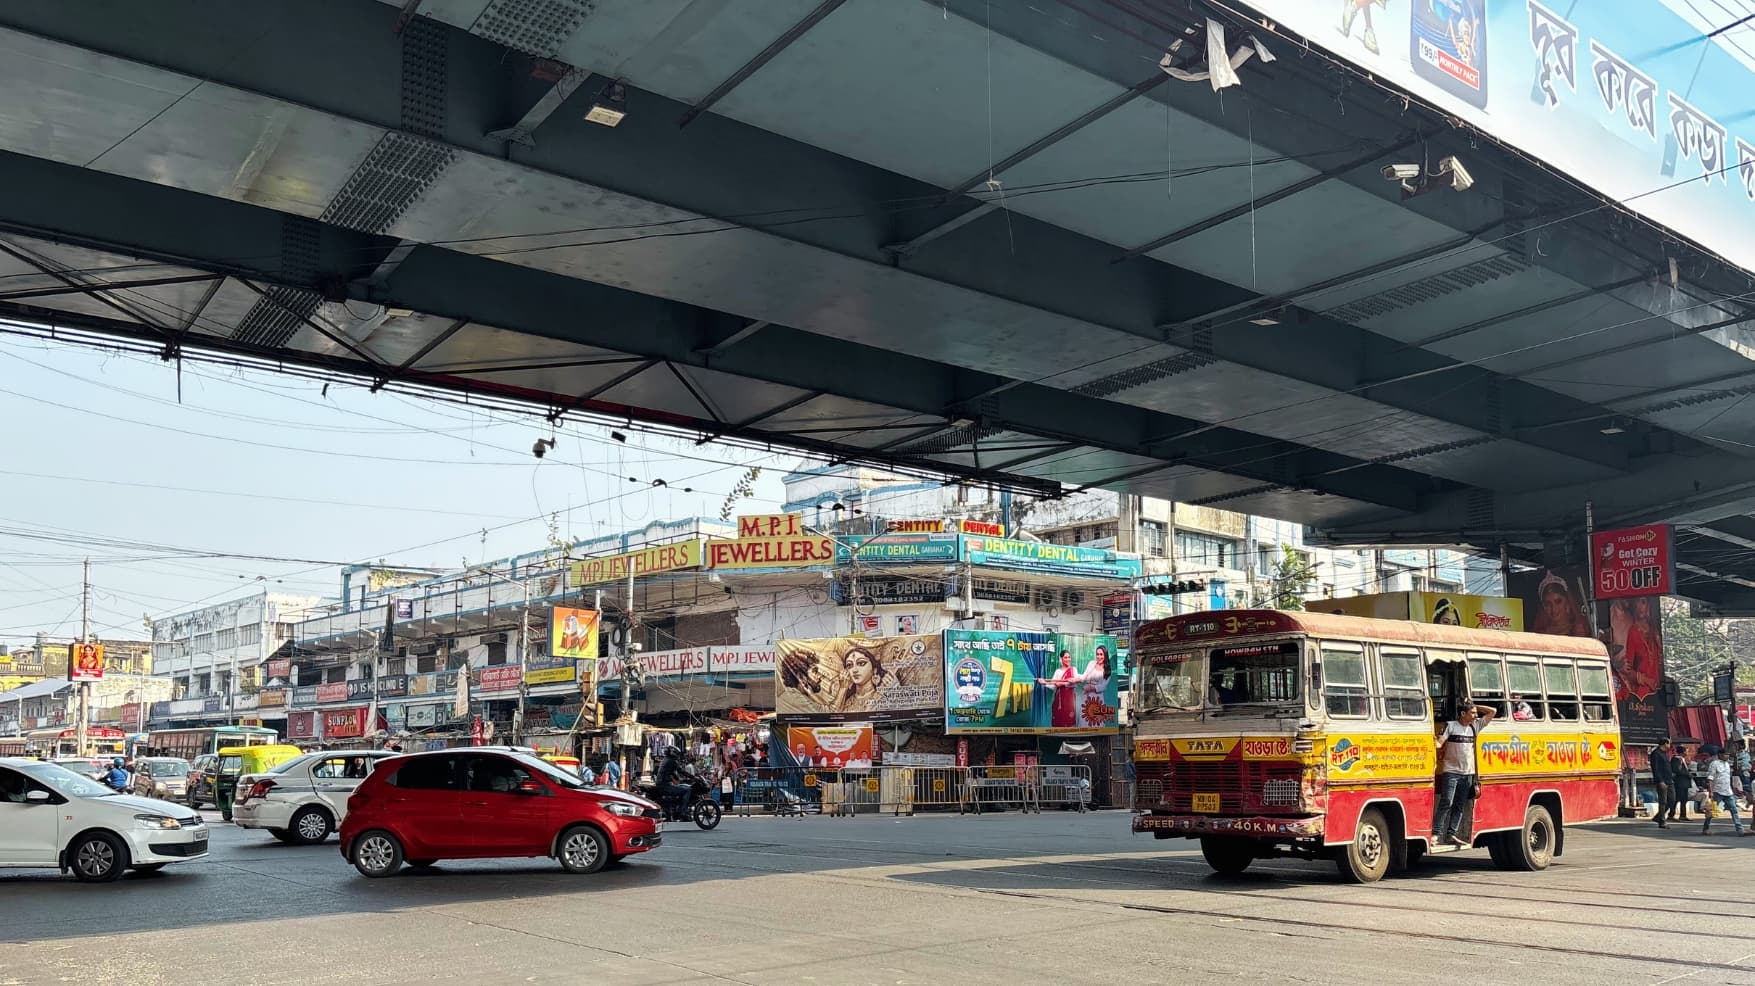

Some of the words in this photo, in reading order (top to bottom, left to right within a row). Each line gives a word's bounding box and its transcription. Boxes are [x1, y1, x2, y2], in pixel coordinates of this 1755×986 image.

[1439, 55, 1462, 75] MONTHLY
[1528, 1, 1578, 108] দূর
[1590, 38, 1657, 141] করে
[1668, 90, 1727, 186] কড়া
[963, 521, 1002, 536] DENTAL
[709, 539, 833, 569] JEWELLERS
[887, 545, 920, 556] DENTAL
[985, 539, 1034, 557] DENTITY
[1037, 542, 1080, 562] DENTAL
[1636, 547, 1658, 558] Cozy
[580, 560, 604, 583] MPJ
[608, 544, 689, 580] JEWELLERS
[1622, 557, 1655, 567] WINTER
[1601, 568, 1630, 592] 50
[1631, 565, 1661, 589] OFF
[896, 580, 941, 595] DENTAL
[712, 652, 739, 665] MPJ
[743, 652, 775, 664] JEW
[1224, 647, 1262, 657] HOWRAH
[1151, 654, 1192, 664] GOLFGREEN
[884, 690, 920, 699] Saraswati
[922, 689, 939, 698] Puja
[1095, 706, 1116, 714] SUN
[1187, 740, 1224, 751] TATA
[1245, 740, 1274, 756] হাওড়া
[1546, 741, 1578, 768] হাওড়া
[1143, 819, 1175, 829] SPEED
[1233, 823, 1251, 832] 40
